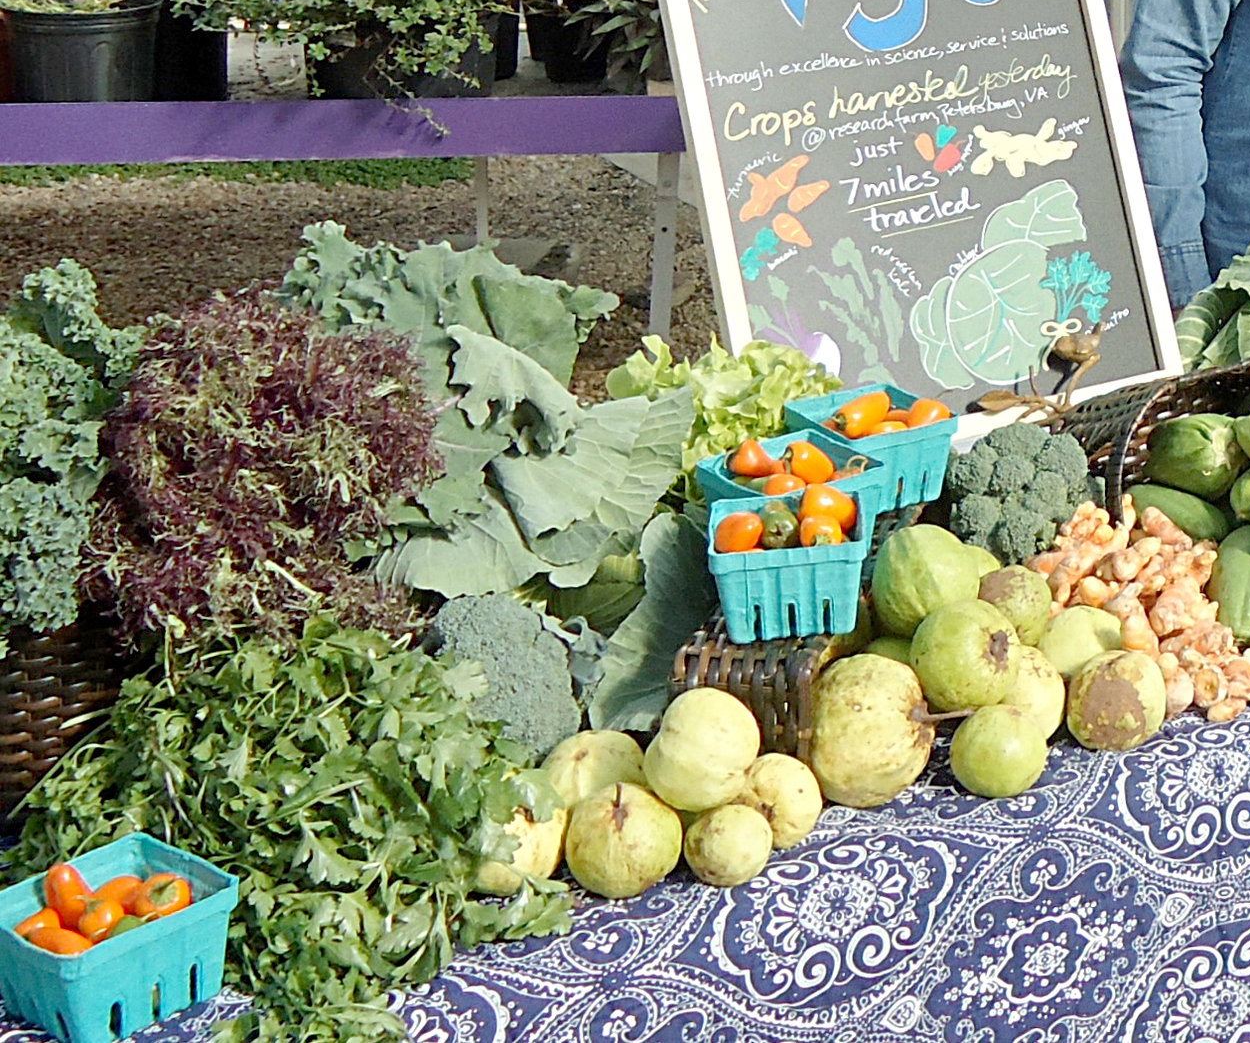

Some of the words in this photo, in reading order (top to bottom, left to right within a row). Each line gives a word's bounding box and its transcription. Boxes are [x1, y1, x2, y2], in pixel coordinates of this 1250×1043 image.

[705, 60, 774, 92] through
[779, 53, 864, 76] excellence
[866, 53, 881, 68] in
[884, 45, 944, 66] science,
[946, 35, 1000, 55] service
[1010, 22, 1070, 42] solutions
[723, 101, 817, 146] Crops
[828, 65, 978, 119] harvested
[966, 54, 1077, 108] yesterday
[828, 111, 894, 141] research
[1024, 89, 1049, 105] VA
[726, 151, 783, 201] turmeric
[850, 136, 904, 167] just
[864, 187, 982, 233] traveled
